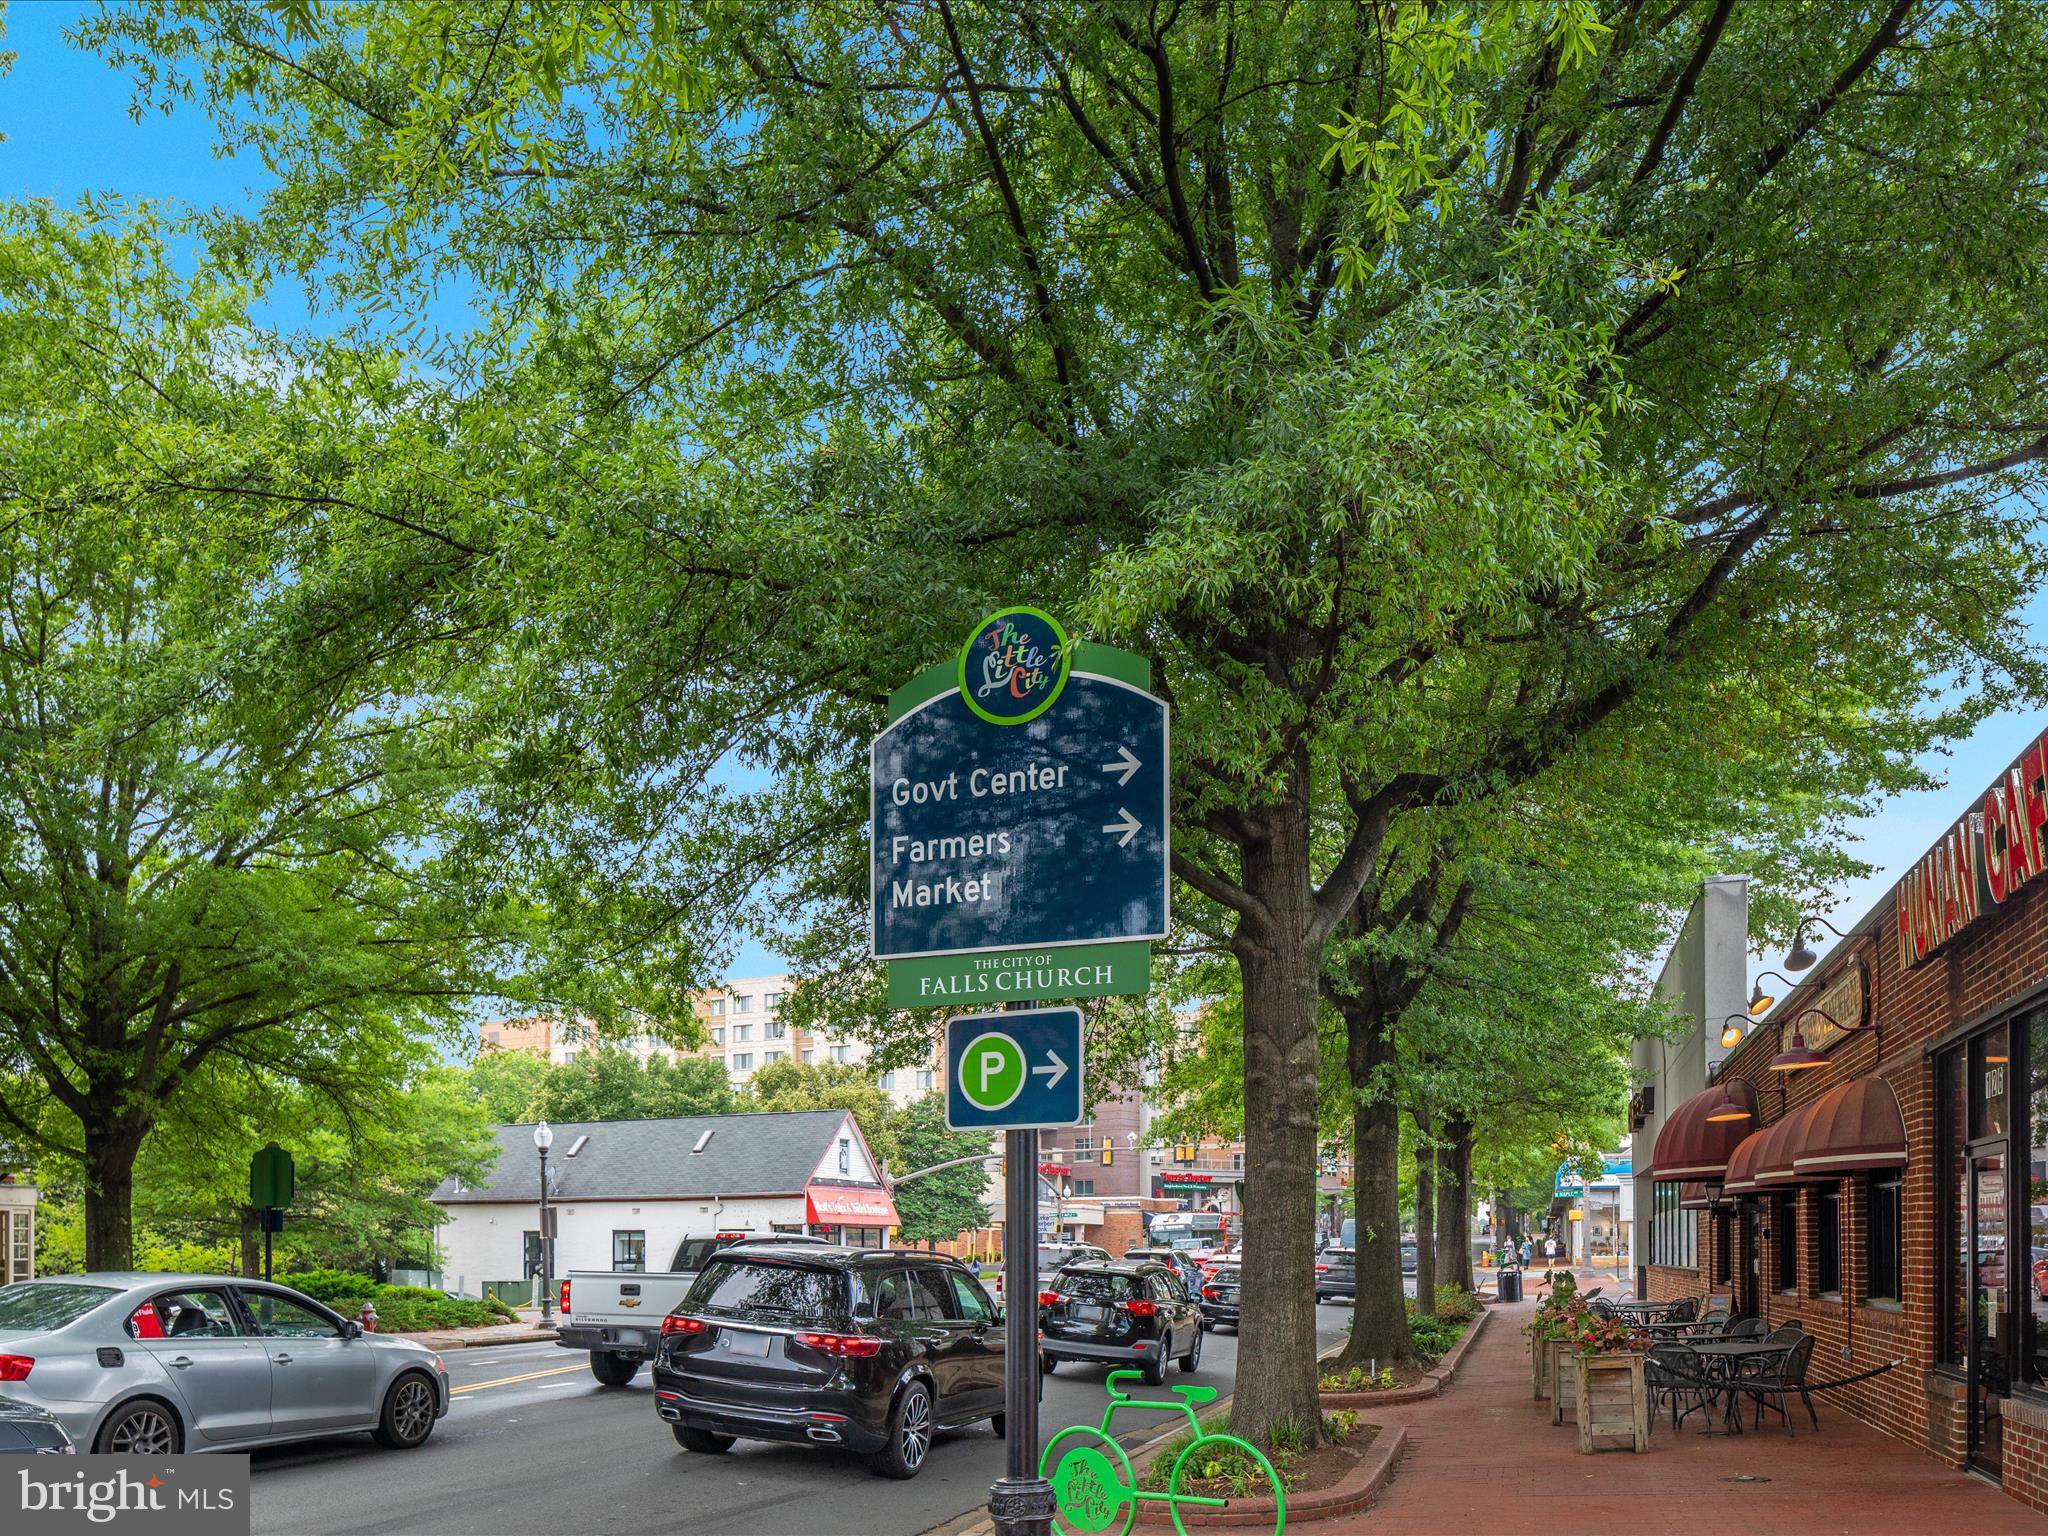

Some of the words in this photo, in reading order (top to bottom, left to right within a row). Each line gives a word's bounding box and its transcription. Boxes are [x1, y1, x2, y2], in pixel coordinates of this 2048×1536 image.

[985, 622, 1032, 651] The
[978, 644, 1048, 698] Little
[1010, 666, 1051, 699] City
[891, 771, 959, 807] Govt
[969, 761, 1069, 798] Center
[891, 830, 1012, 865] Farmers
[1896, 813, 1982, 971] HUNAN
[1983, 735, 2048, 905] CAF
[891, 871, 992, 909] Market
[973, 958, 1000, 970] THE
[1001, 955, 1034, 969] CITY
[1034, 954, 1053, 966] OF
[919, 972, 989, 997] FALLS
[995, 964, 1114, 991] CHURCH
[980, 1051, 1006, 1093] P
[1068, 1458, 1097, 1480] The
[1064, 1477, 1109, 1513] Little
[1085, 1496, 1111, 1521] City
